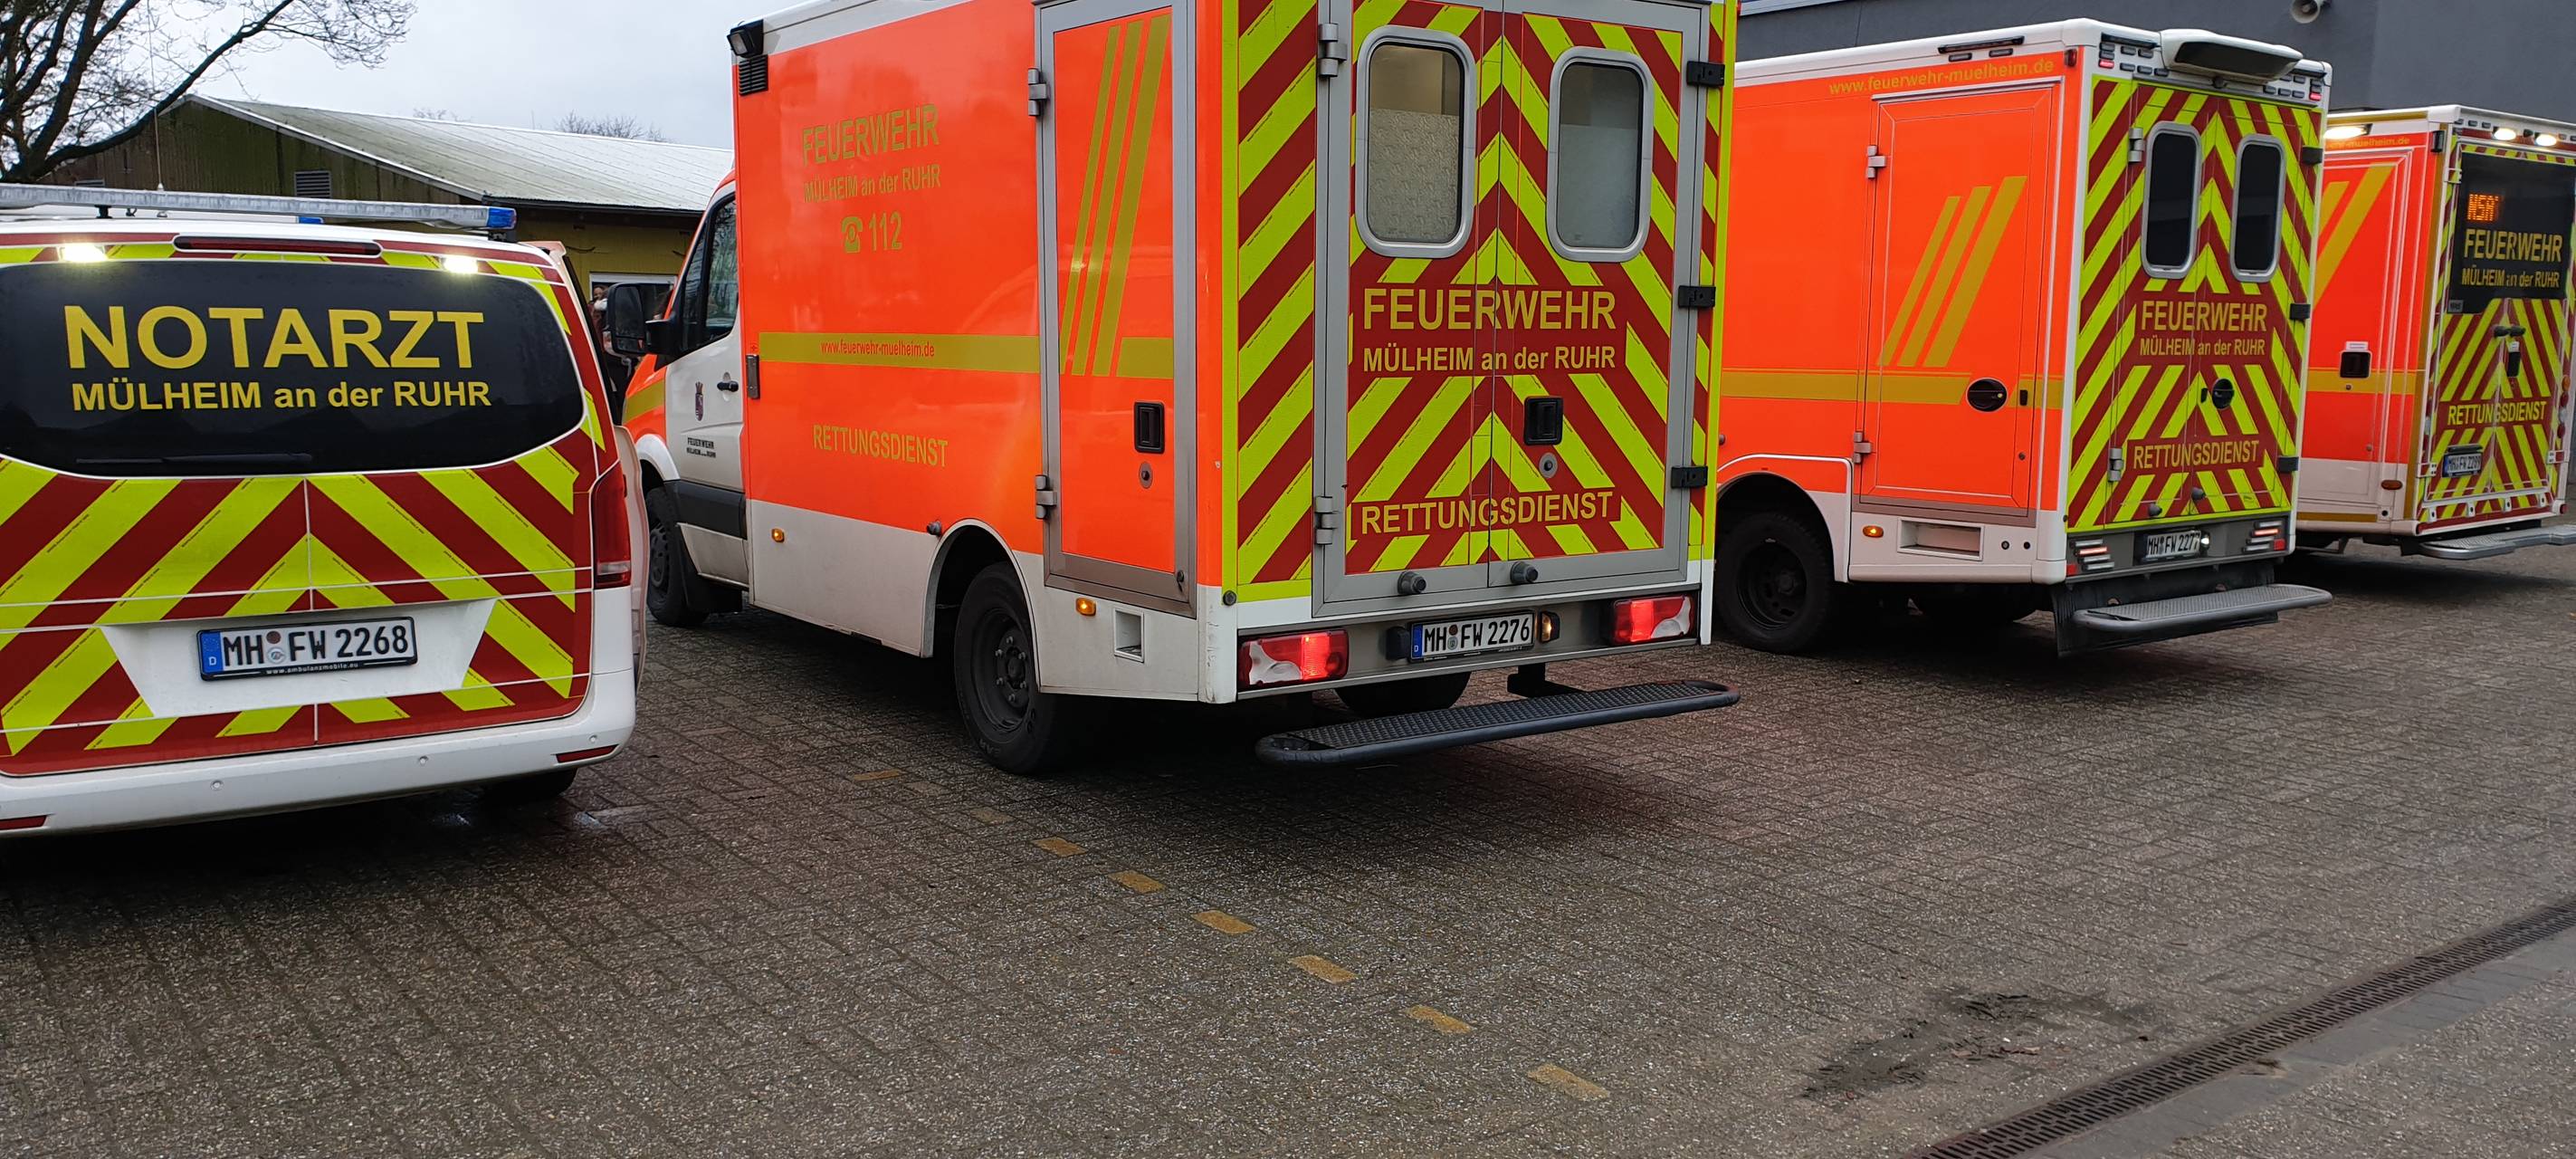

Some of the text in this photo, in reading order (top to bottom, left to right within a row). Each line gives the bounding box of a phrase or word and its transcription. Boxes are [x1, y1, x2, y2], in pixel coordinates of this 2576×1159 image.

[1829, 58, 2054, 95] www.feuerwehr-muelheim.de
[802, 104, 940, 168] FEUERWEHR
[804, 164, 941, 204] MÜLHEIM an der RUHR
[869, 211, 902, 252] 112
[2464, 228, 2563, 263] FEUERWEHR
[2462, 264, 2505, 286] MÜLHEIM
[2519, 271, 2533, 287] der
[2534, 271, 2561, 288] RUHR
[1363, 288, 1617, 330] FEUERWEHR
[2141, 301, 2267, 332] FEUERWEHR
[64, 305, 484, 369] NOTARZT
[820, 339, 935, 357] www.feuerwehr-muelheim.de
[2140, 334, 2266, 356] MÜLHEIM an der RUHR
[1363, 342, 1616, 372] MÜLHEIM an der RUHR
[72, 377, 492, 411] MÜLHEIM an der RUHR
[2447, 400, 2547, 426] RETTUNGSDIENST
[813, 424, 949, 467] RETTUNGSDIENST
[2133, 440, 2260, 469] RETTUNGSDIENST
[1361, 491, 1613, 534] RETTUNGSDIENST
[209, 625, 409, 666] D MH FW 2268
[1424, 627, 1447, 653] MH
[1461, 622, 1484, 648] FW
[1488, 618, 1530, 645] 2276
[266, 662, 359, 675] www.ambulanzmobile.eu
